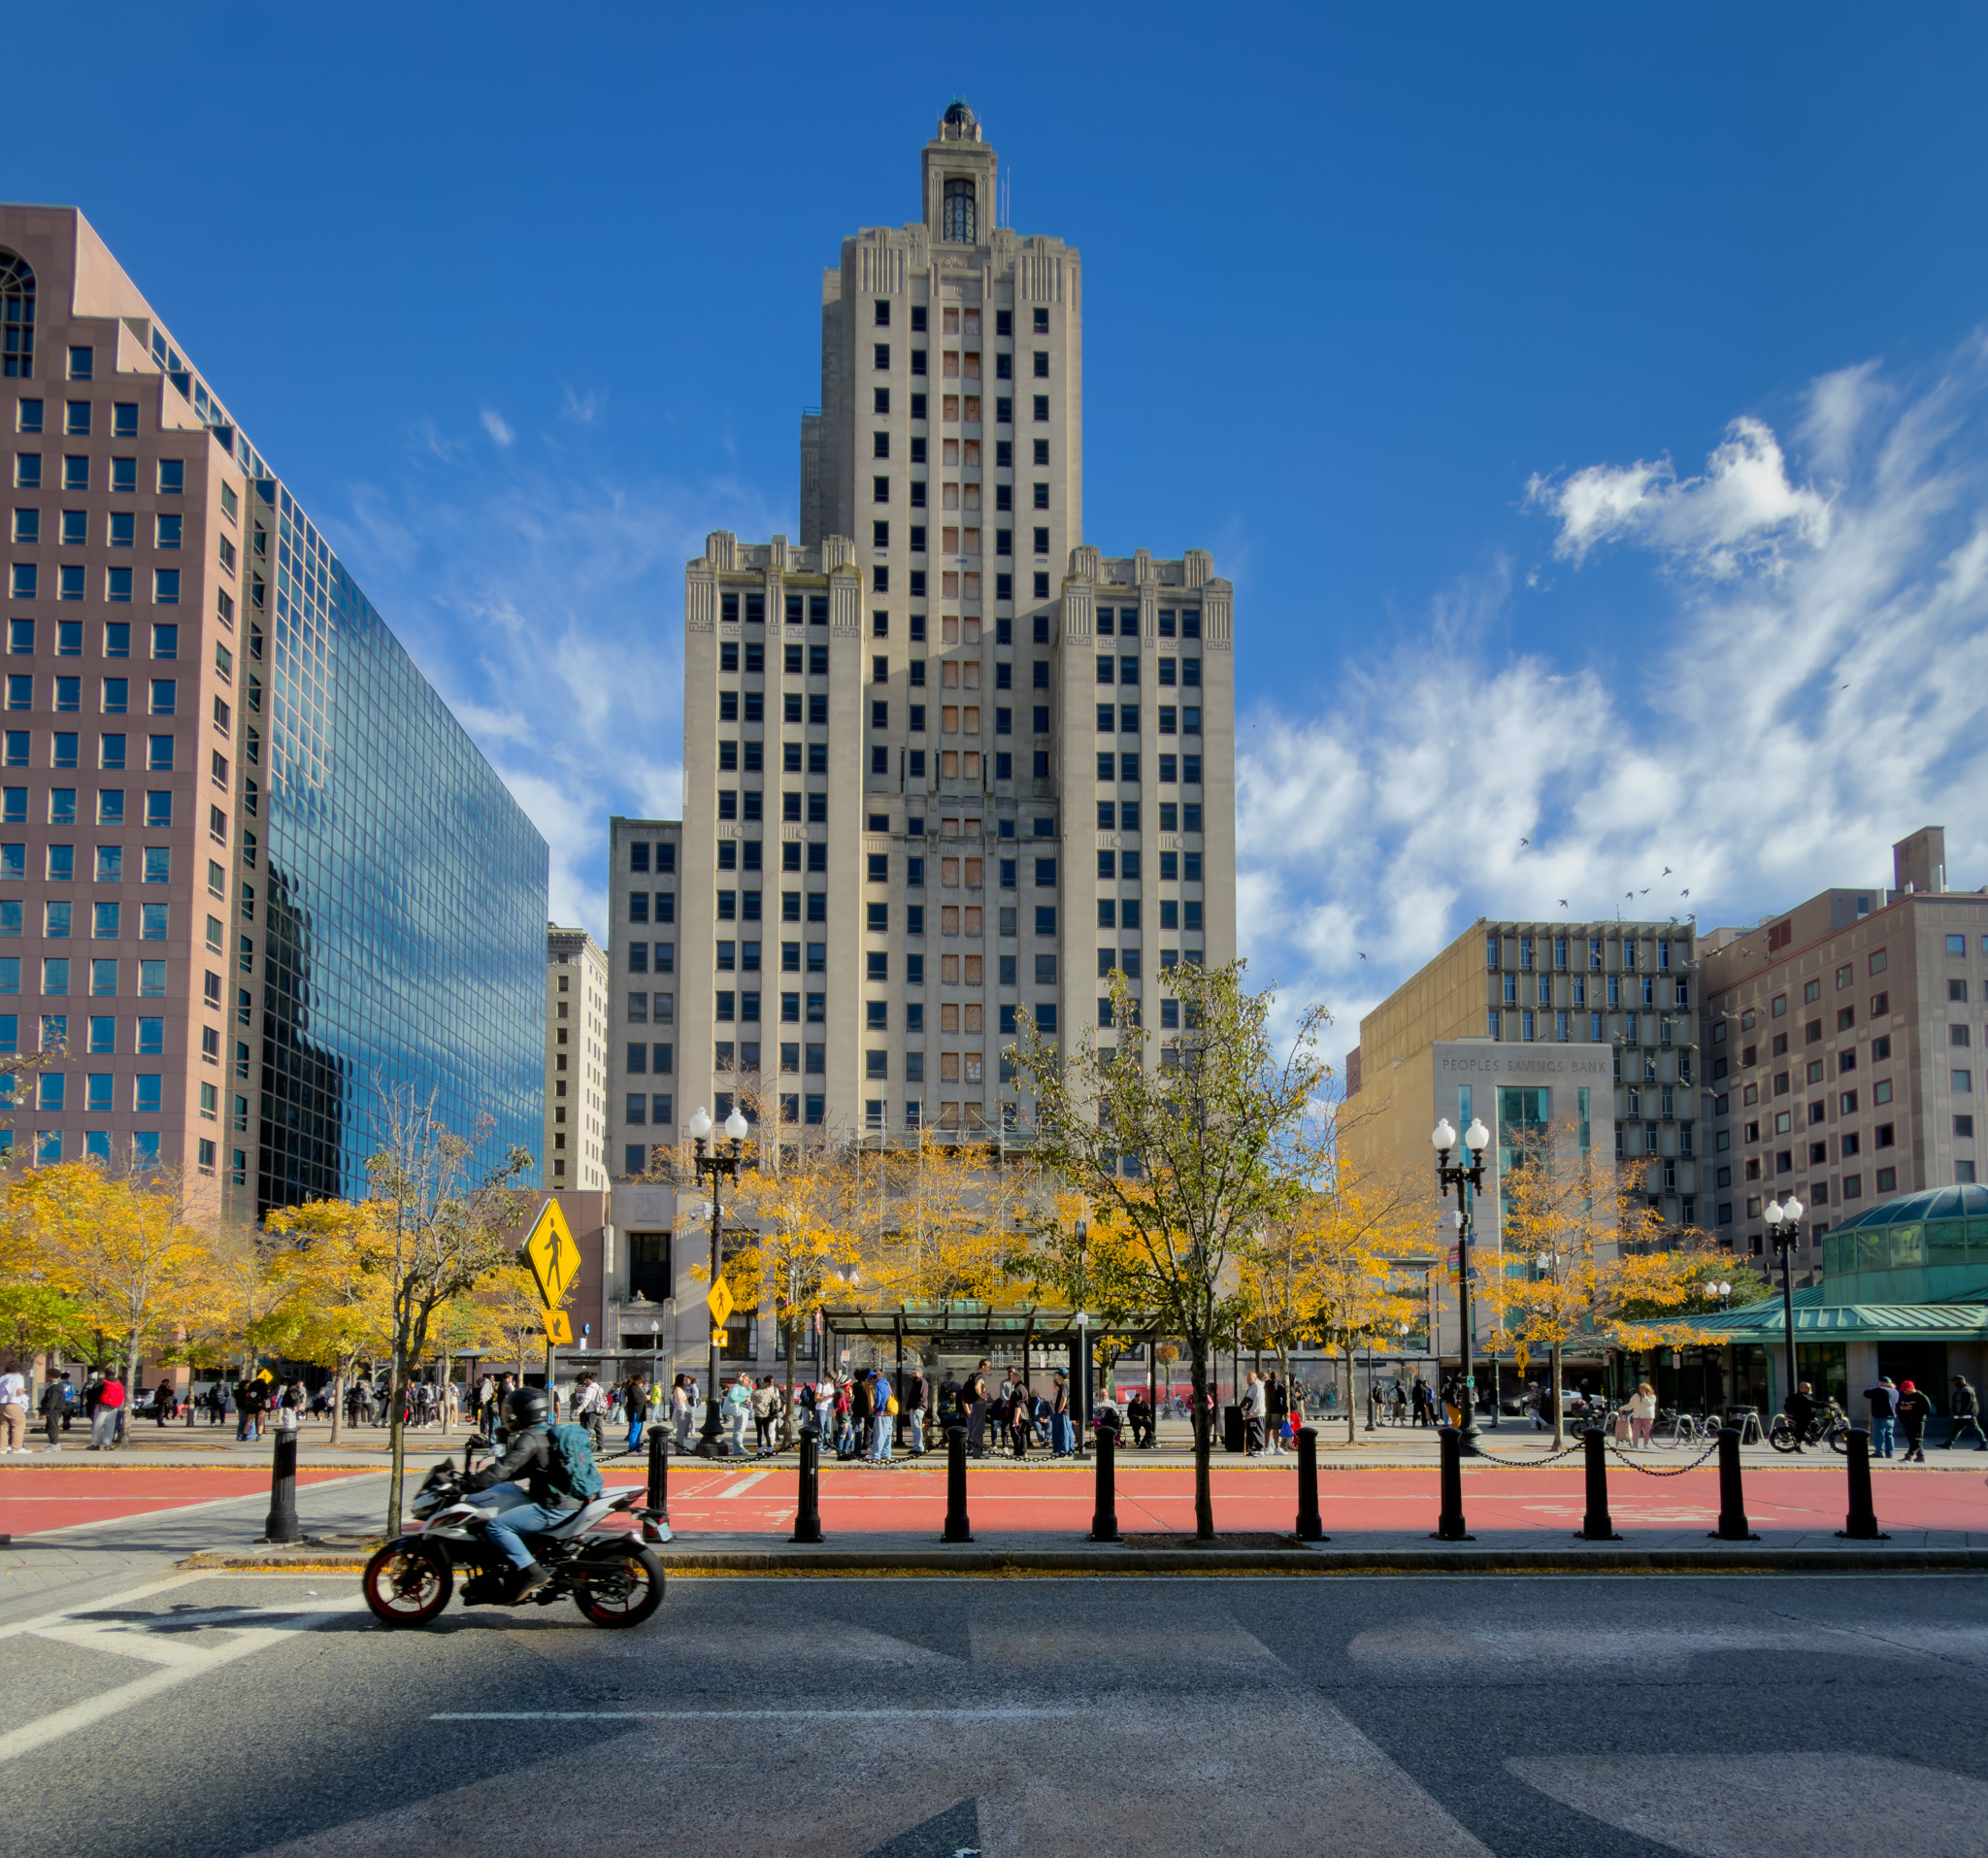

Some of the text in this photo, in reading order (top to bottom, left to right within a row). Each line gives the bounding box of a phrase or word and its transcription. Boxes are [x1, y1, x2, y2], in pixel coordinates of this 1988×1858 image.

[1442, 1059, 1607, 1073] PEOPLES SAVINGS BANK
